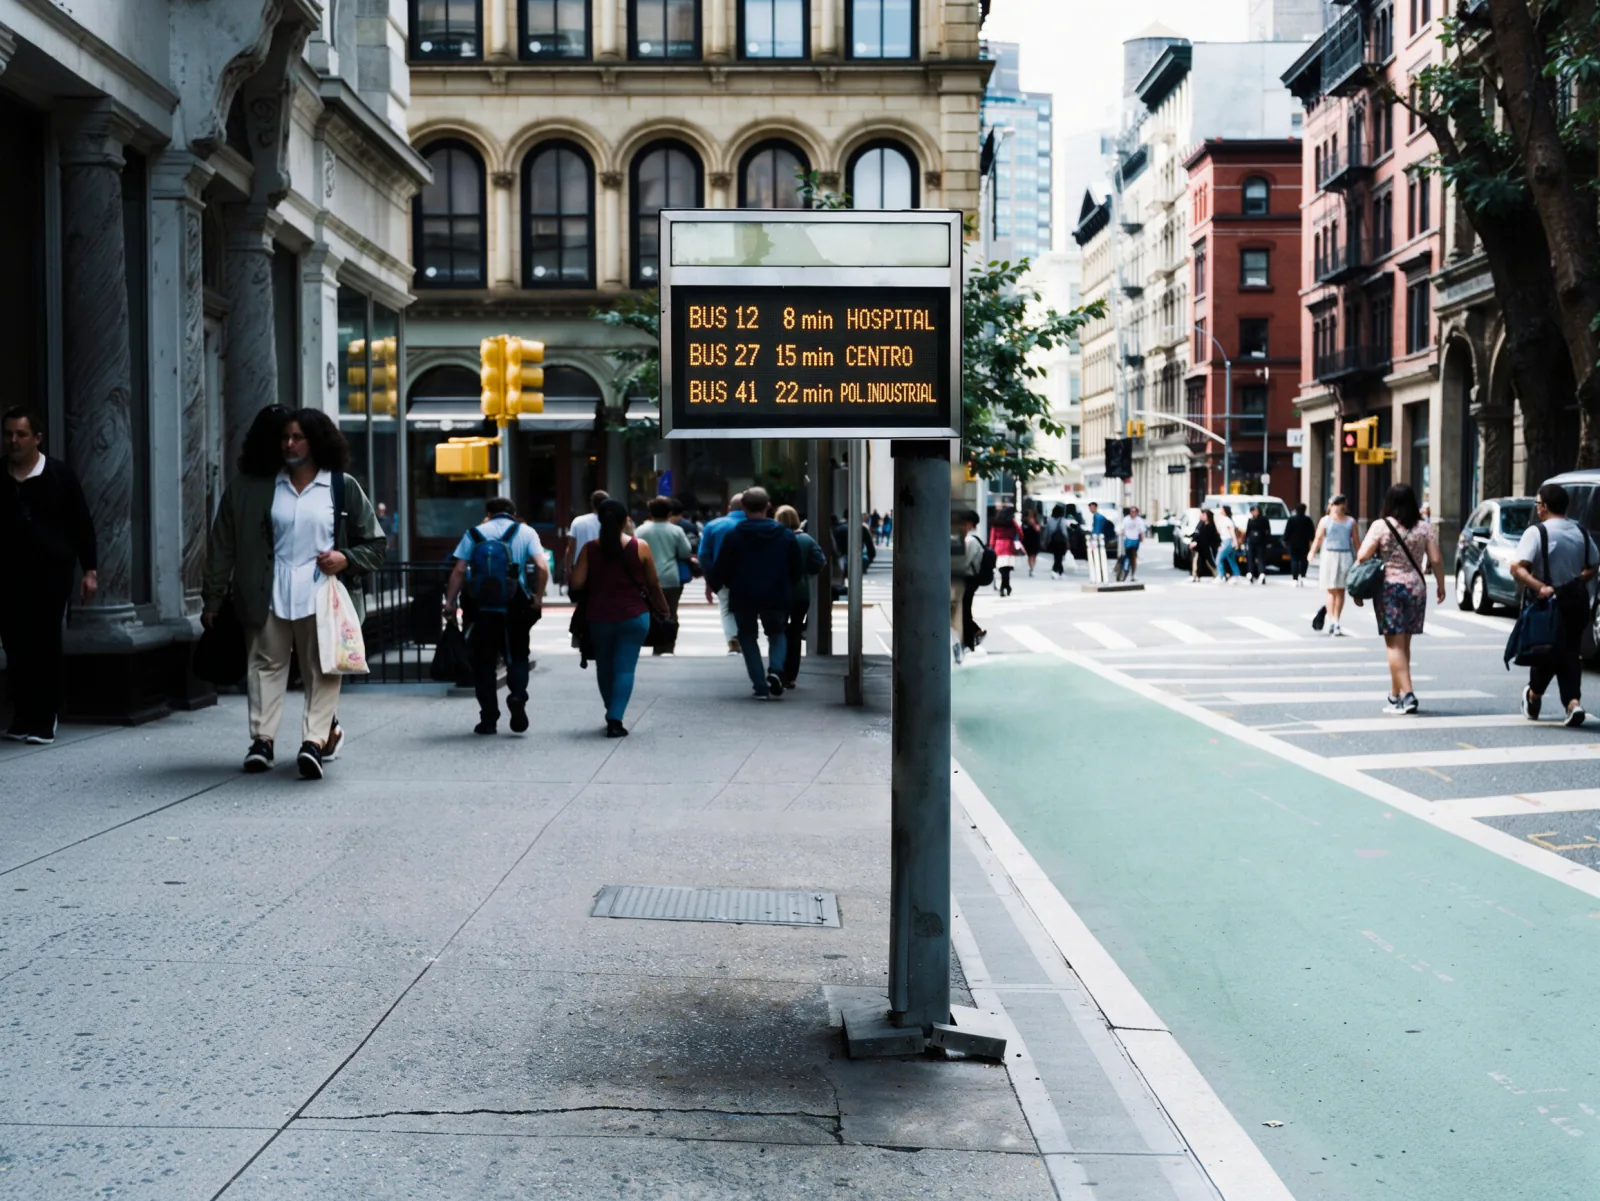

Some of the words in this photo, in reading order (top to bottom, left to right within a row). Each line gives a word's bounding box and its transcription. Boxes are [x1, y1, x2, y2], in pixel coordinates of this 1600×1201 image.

[690, 306, 727, 328] BUS
[736, 306, 758, 328] 12
[784, 307, 795, 329] 8
[802, 310, 832, 329] min
[847, 309, 934, 330] HOSPITAL
[690, 344, 727, 365] BUS
[735, 344, 760, 365] 27
[776, 344, 796, 366] 15
[803, 347, 833, 366] min
[846, 346, 912, 366] CENTRO
[690, 381, 727, 402] BUS
[735, 381, 757, 402] 41
[776, 381, 798, 403] 22
[803, 384, 832, 402] min
